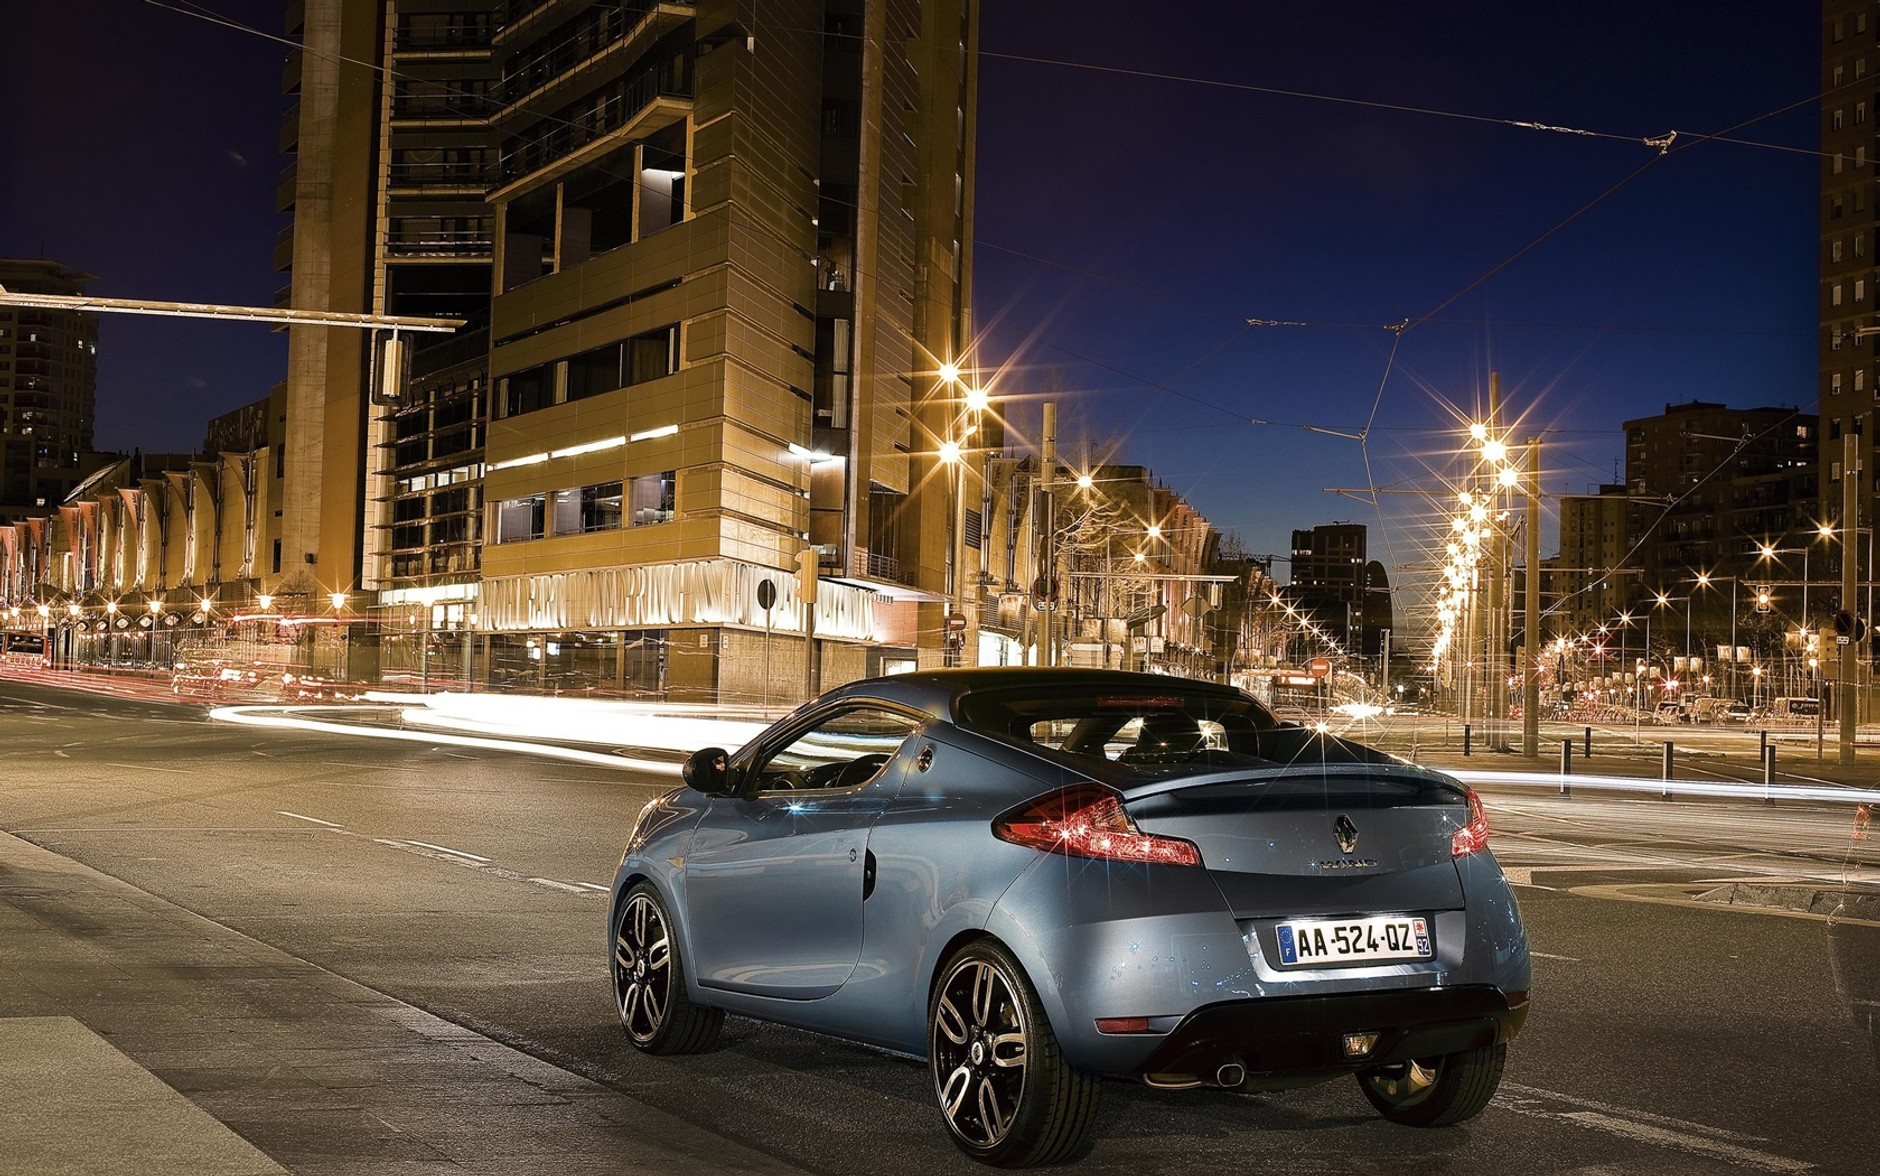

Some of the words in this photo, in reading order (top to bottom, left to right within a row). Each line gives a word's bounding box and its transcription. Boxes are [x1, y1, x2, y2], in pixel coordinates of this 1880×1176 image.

[1320, 859, 1379, 870] WIND
[1298, 923, 1414, 958] AA-524-QZ
[1417, 938, 1430, 952] 92
[1285, 948, 1291, 957] F
